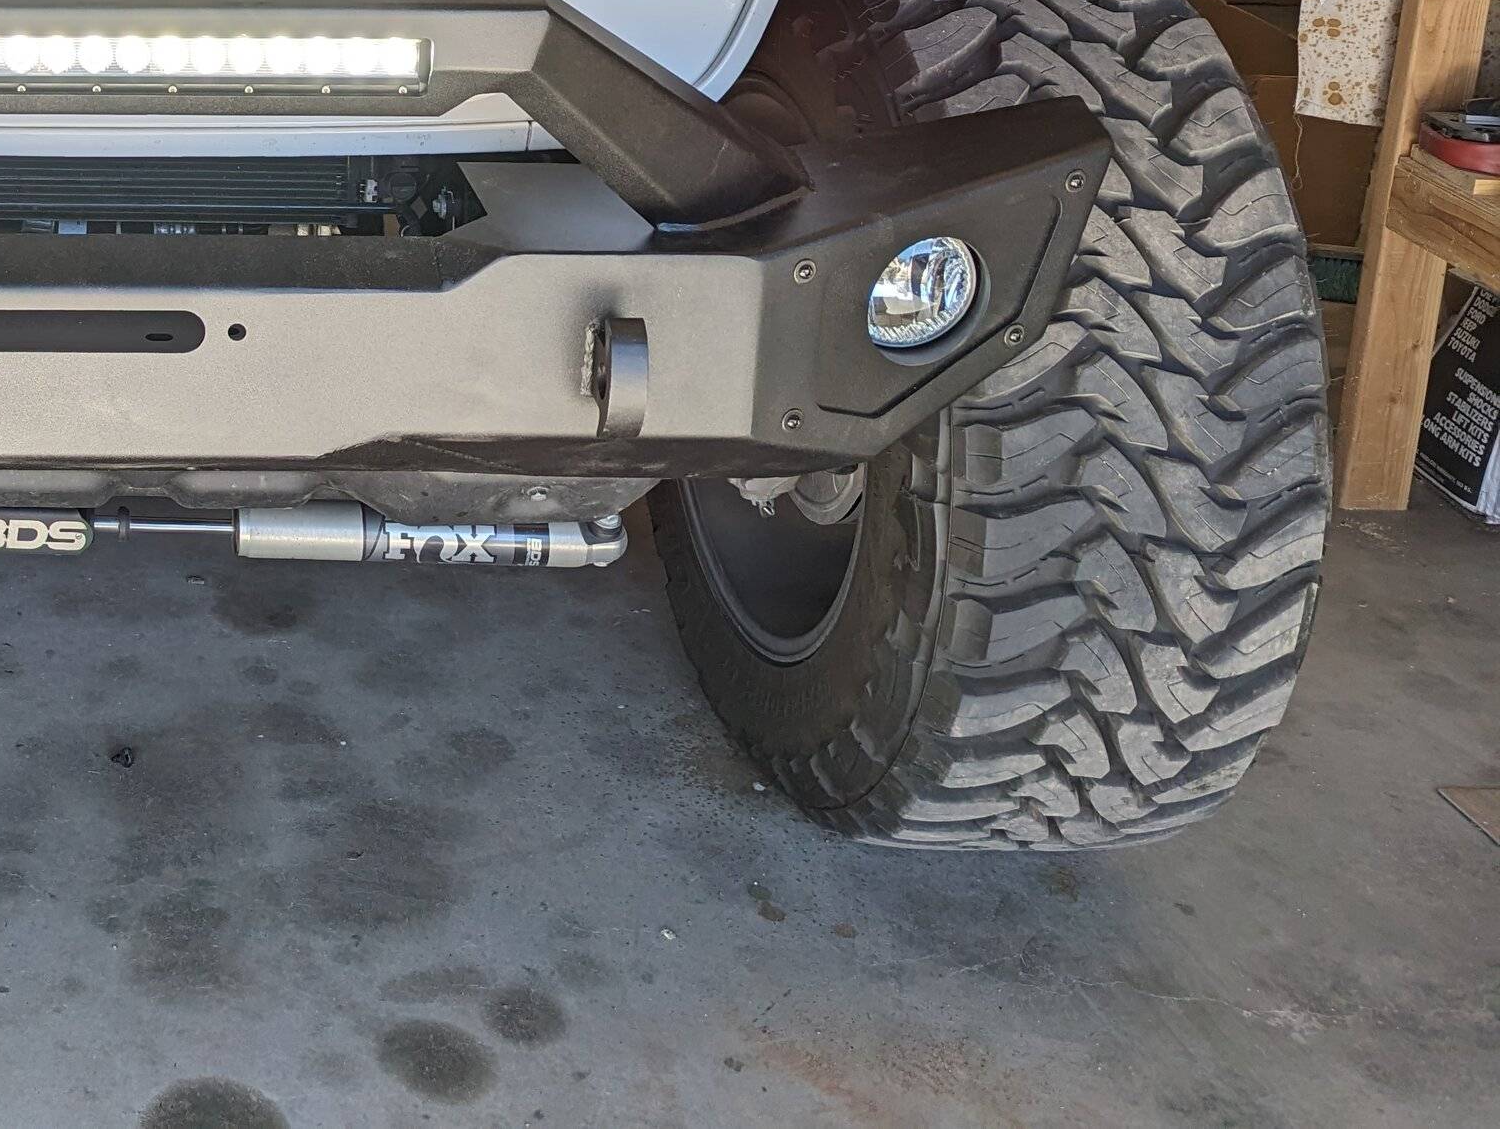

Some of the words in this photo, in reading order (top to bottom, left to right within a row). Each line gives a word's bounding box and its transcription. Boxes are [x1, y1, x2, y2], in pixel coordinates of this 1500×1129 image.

[1460, 317, 1478, 332] JEEP
[1466, 306, 1486, 325] FORD
[1447, 336, 1477, 363] TOYOTA
[1453, 327, 1481, 350] SUZUKI
[1446, 391, 1495, 432] STABILIZERS
[1467, 391, 1499, 420] SHOCKS
[1433, 411, 1486, 456] ACCESSORIES
[1451, 410, 1471, 429] LIFT
[1468, 425, 1490, 444] KITS
[1440, 432, 1461, 453] ARM
[1458, 448, 1482, 468] KITS
[383, 522, 497, 564] FOX
